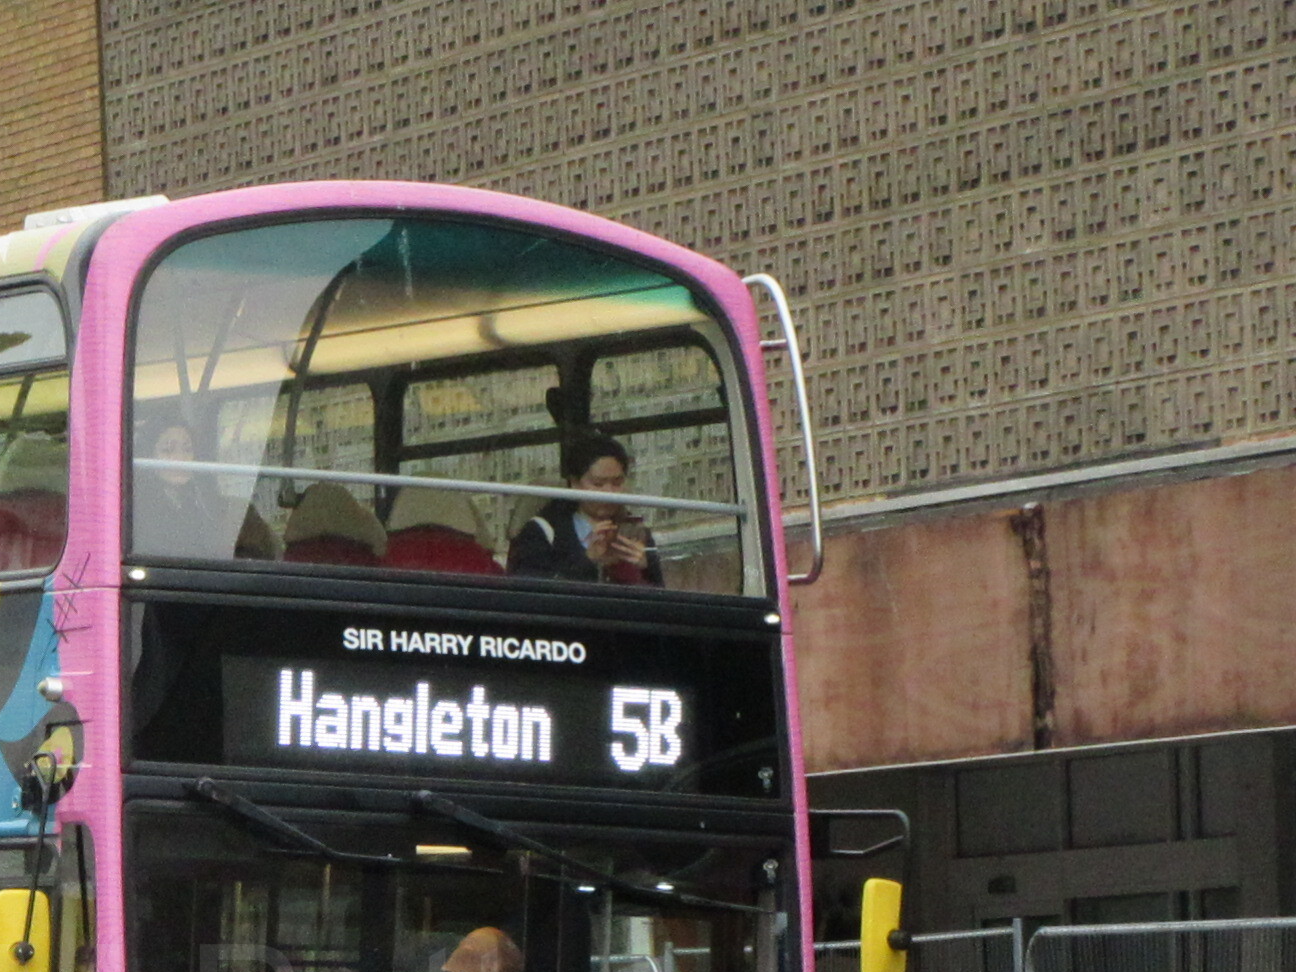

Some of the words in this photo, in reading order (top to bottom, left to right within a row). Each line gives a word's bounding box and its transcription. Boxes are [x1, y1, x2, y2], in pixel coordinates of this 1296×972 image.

[342, 626, 384, 651] SIR
[390, 630, 474, 657] HARRY
[479, 635, 587, 664] RICARDO
[276, 667, 553, 763] Hangleton
[610, 685, 683, 773] 5B
